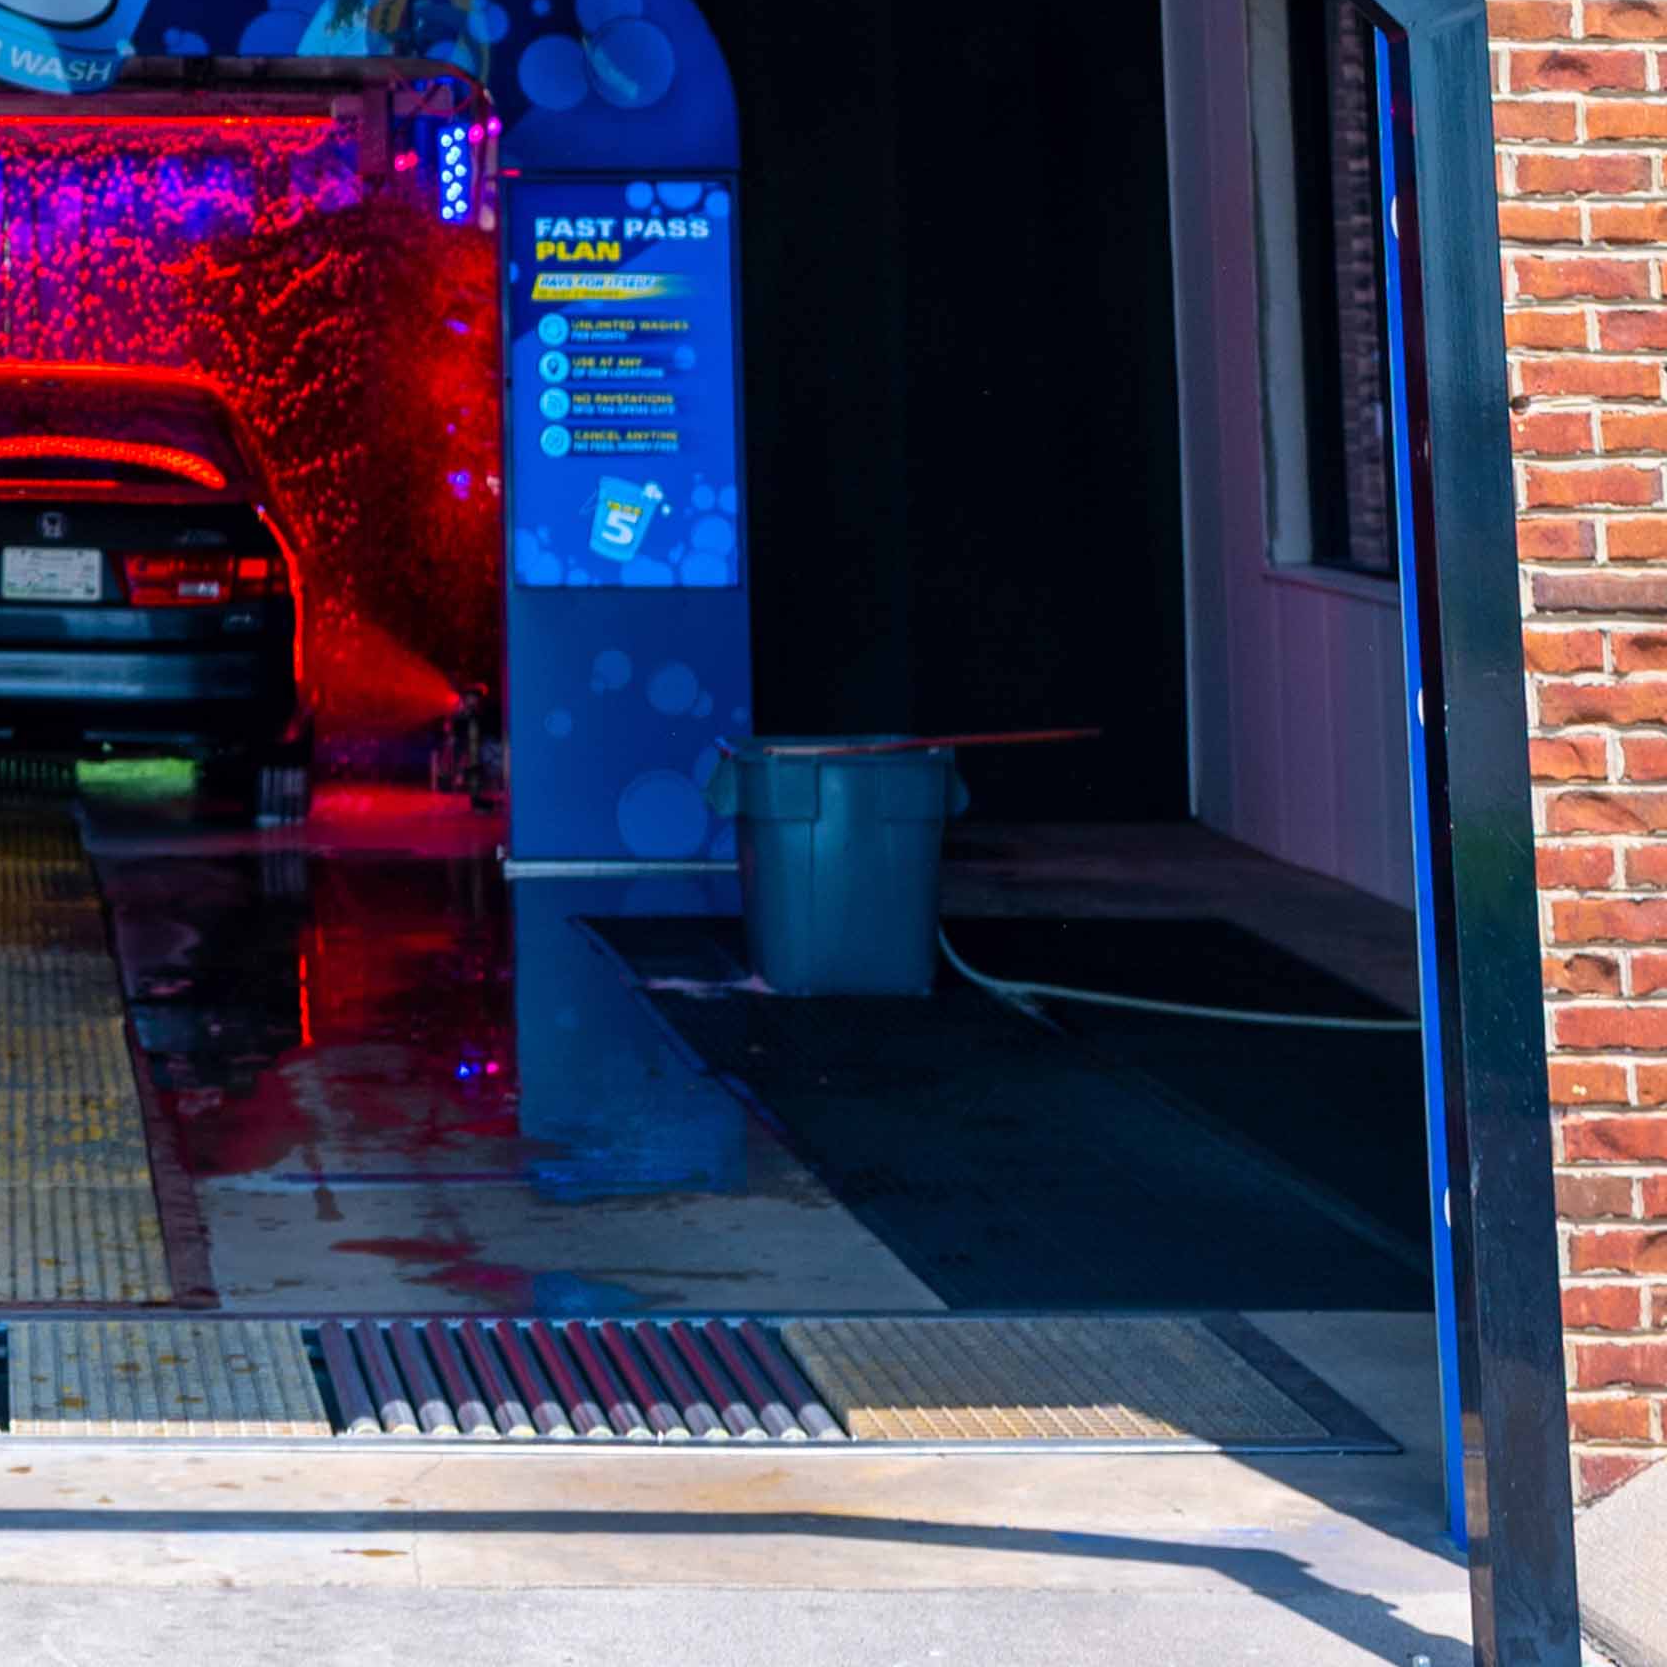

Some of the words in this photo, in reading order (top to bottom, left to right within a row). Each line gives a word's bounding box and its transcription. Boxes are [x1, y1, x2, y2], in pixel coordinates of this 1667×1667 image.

[10, 45, 113, 83] WASH
[535, 218, 615, 238] FAST
[624, 218, 710, 239] PASS
[536, 241, 621, 262] PLAN
[601, 510, 638, 544] 5
